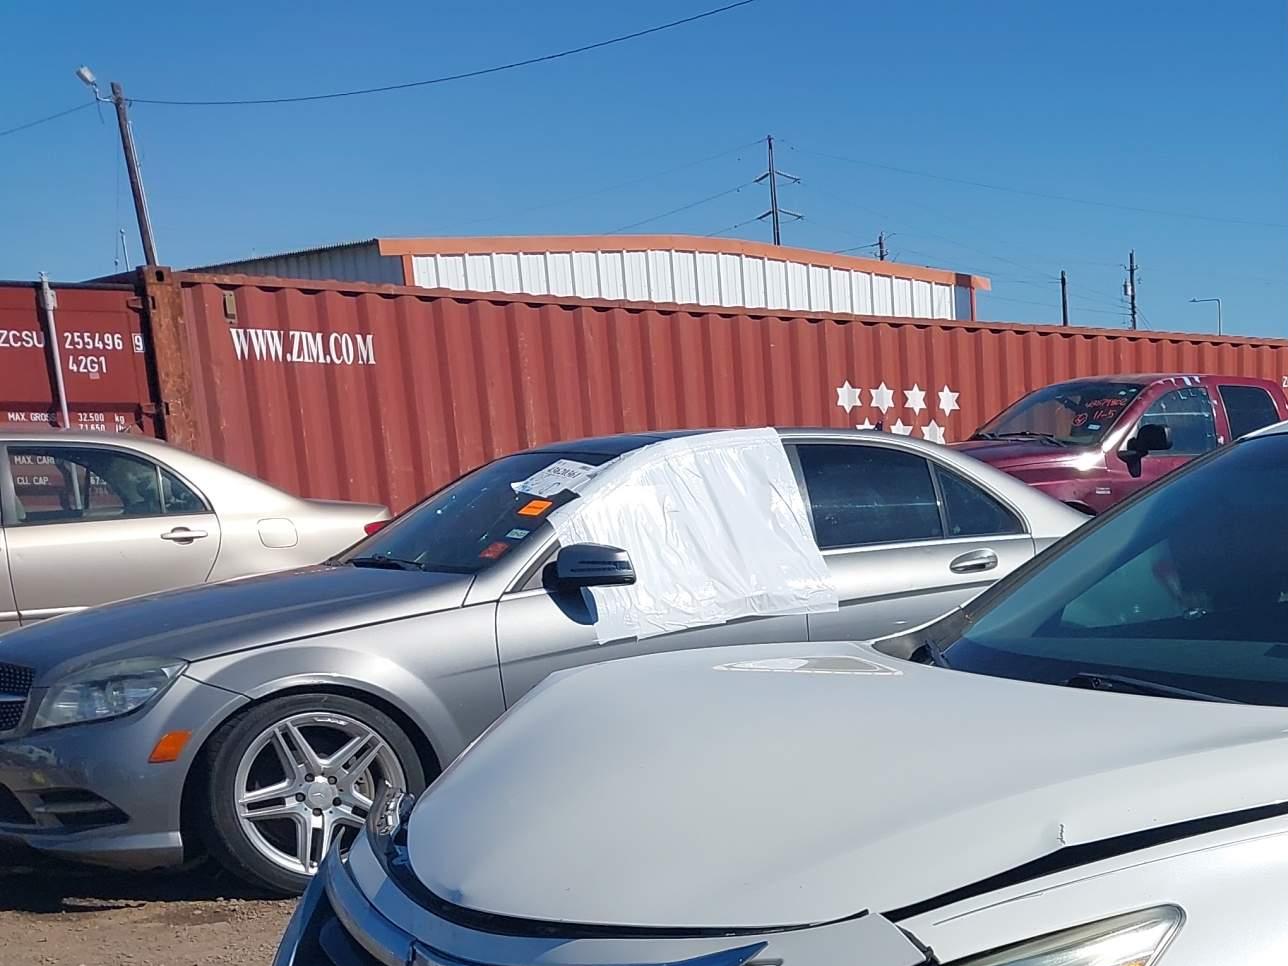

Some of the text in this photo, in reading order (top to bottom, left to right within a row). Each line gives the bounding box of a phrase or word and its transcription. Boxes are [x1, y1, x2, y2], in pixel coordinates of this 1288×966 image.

[0, 330, 45, 348] ZCSU
[64, 332, 124, 350] 255496
[229, 328, 377, 365] WWW.ZIM.COM
[68, 355, 107, 373] 42G1
